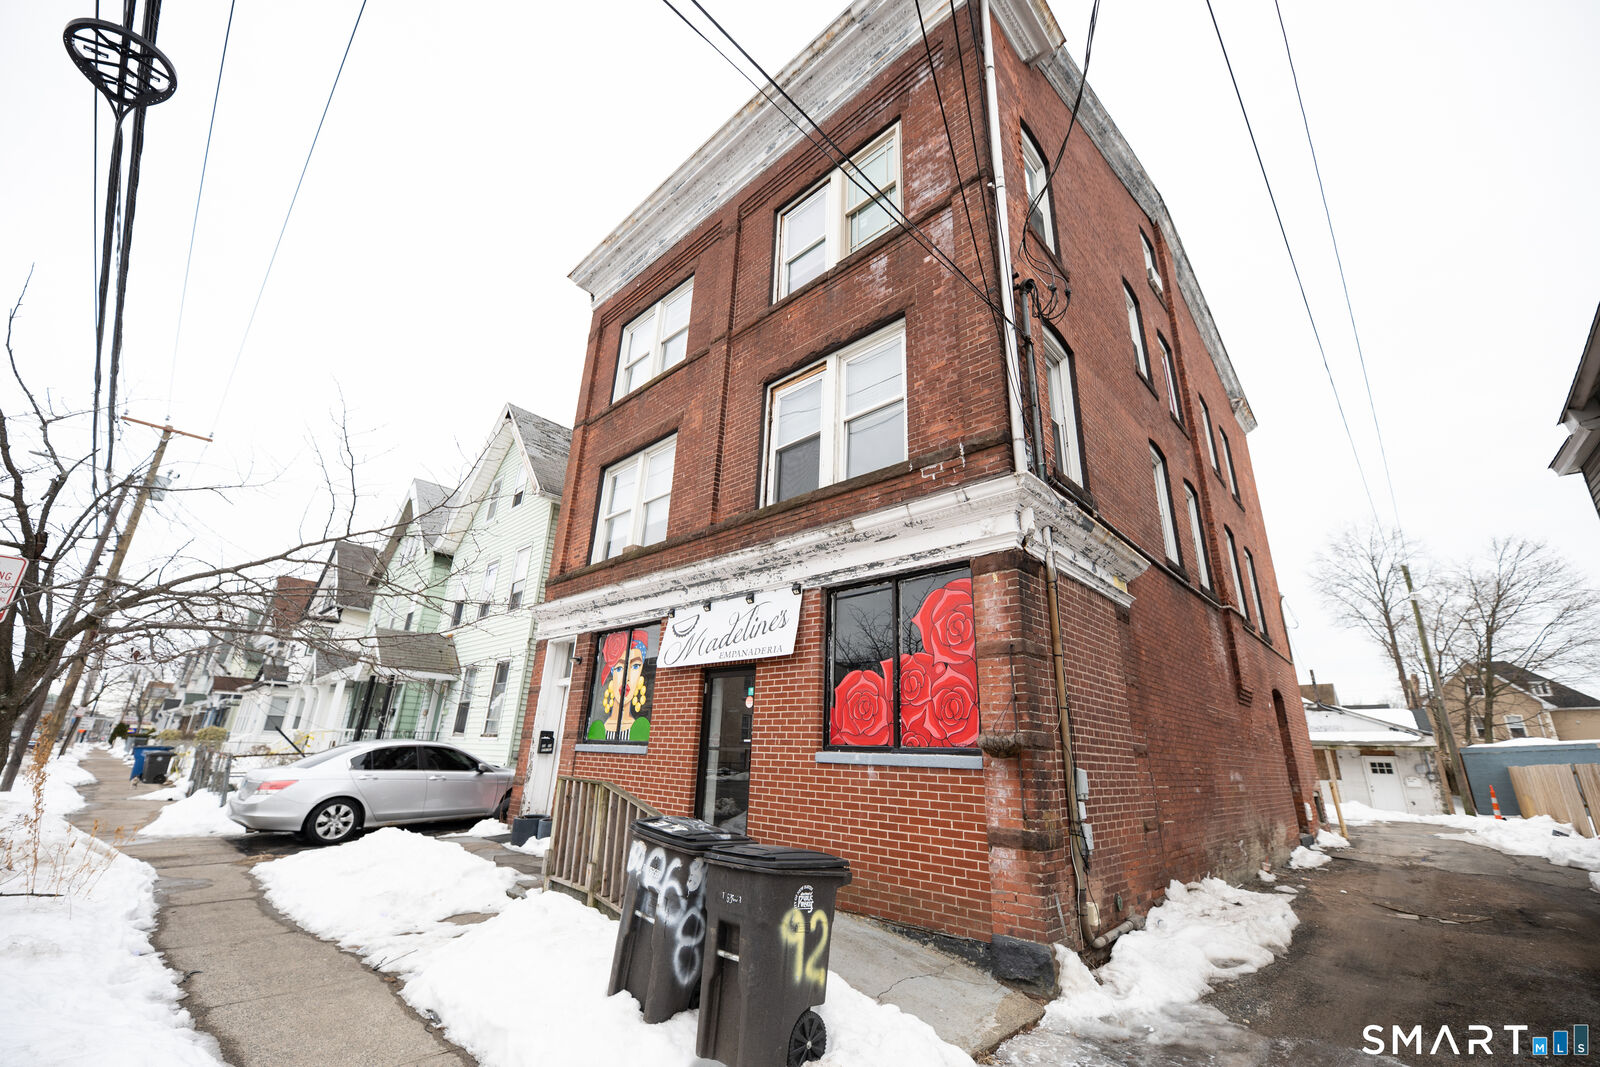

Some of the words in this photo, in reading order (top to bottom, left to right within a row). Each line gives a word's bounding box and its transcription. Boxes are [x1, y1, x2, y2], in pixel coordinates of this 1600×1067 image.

[664, 601, 790, 666] Madeline's
[718, 644, 784, 660] EMPANADERIA
[781, 907, 829, 987] 92
